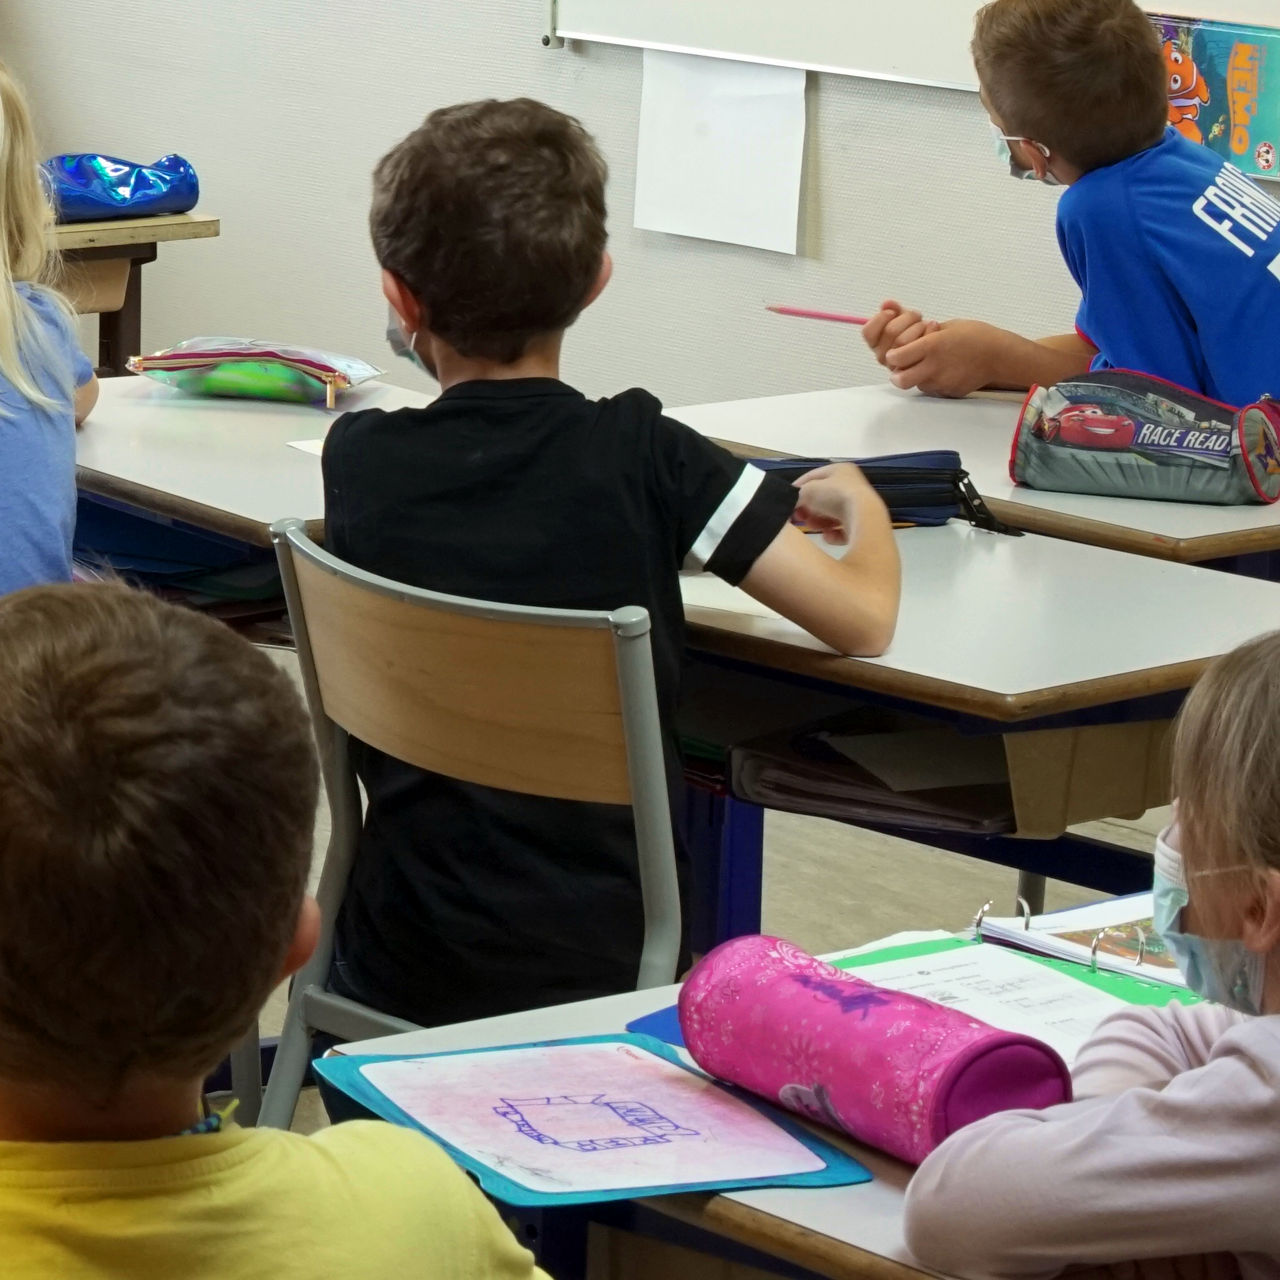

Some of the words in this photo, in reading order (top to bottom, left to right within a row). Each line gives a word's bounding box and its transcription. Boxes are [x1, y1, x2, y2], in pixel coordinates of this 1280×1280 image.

[1230, 41, 1252, 156] NEMO
[1137, 423, 1186, 447] RACE
[1182, 430, 1230, 452] READ
